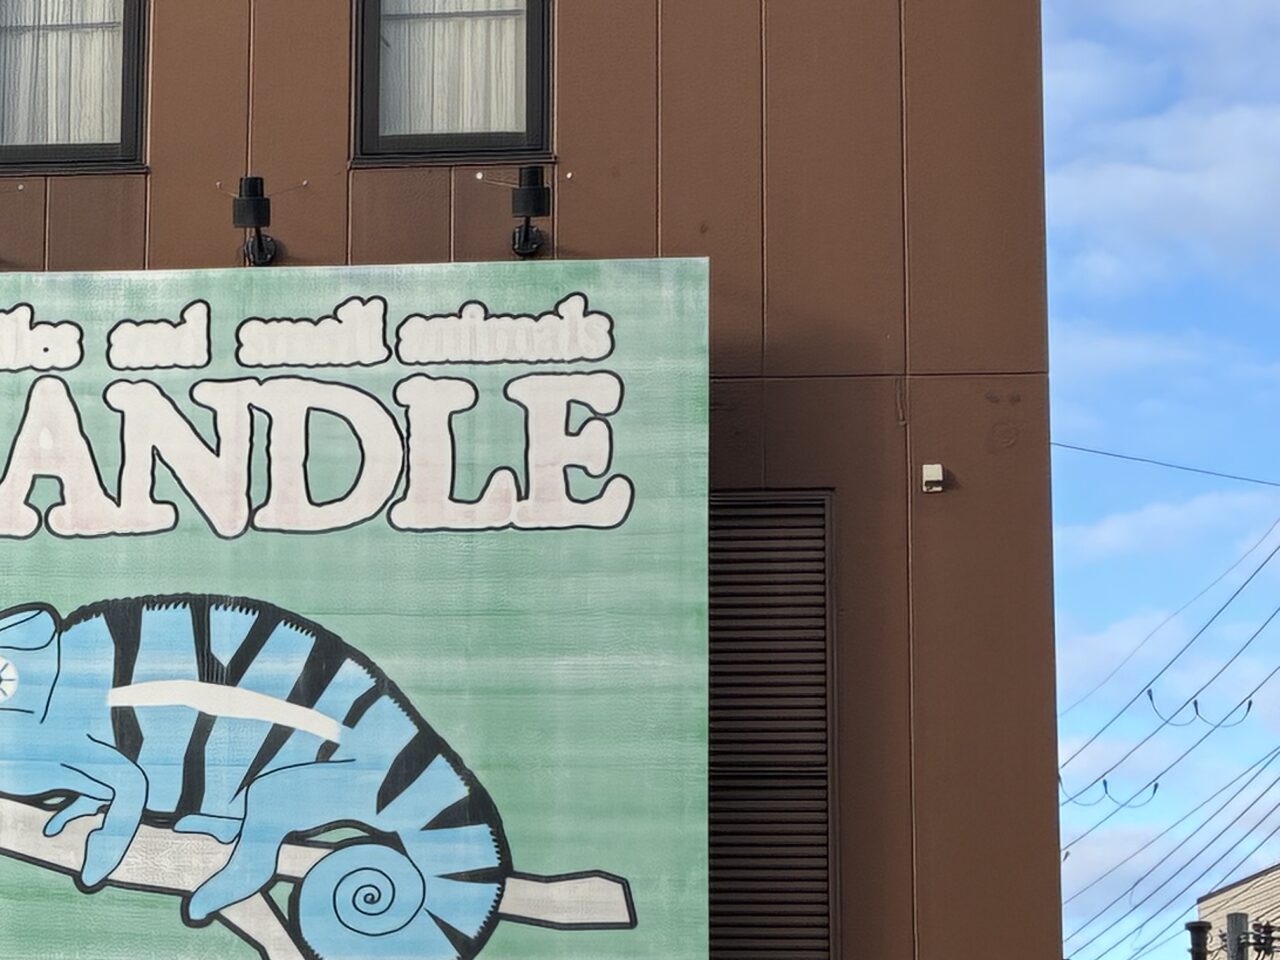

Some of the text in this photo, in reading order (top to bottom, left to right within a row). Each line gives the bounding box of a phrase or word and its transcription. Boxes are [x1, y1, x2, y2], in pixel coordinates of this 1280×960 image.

[106, 299, 212, 370] and
[235, 295, 392, 368] small
[395, 292, 614, 365] animals
